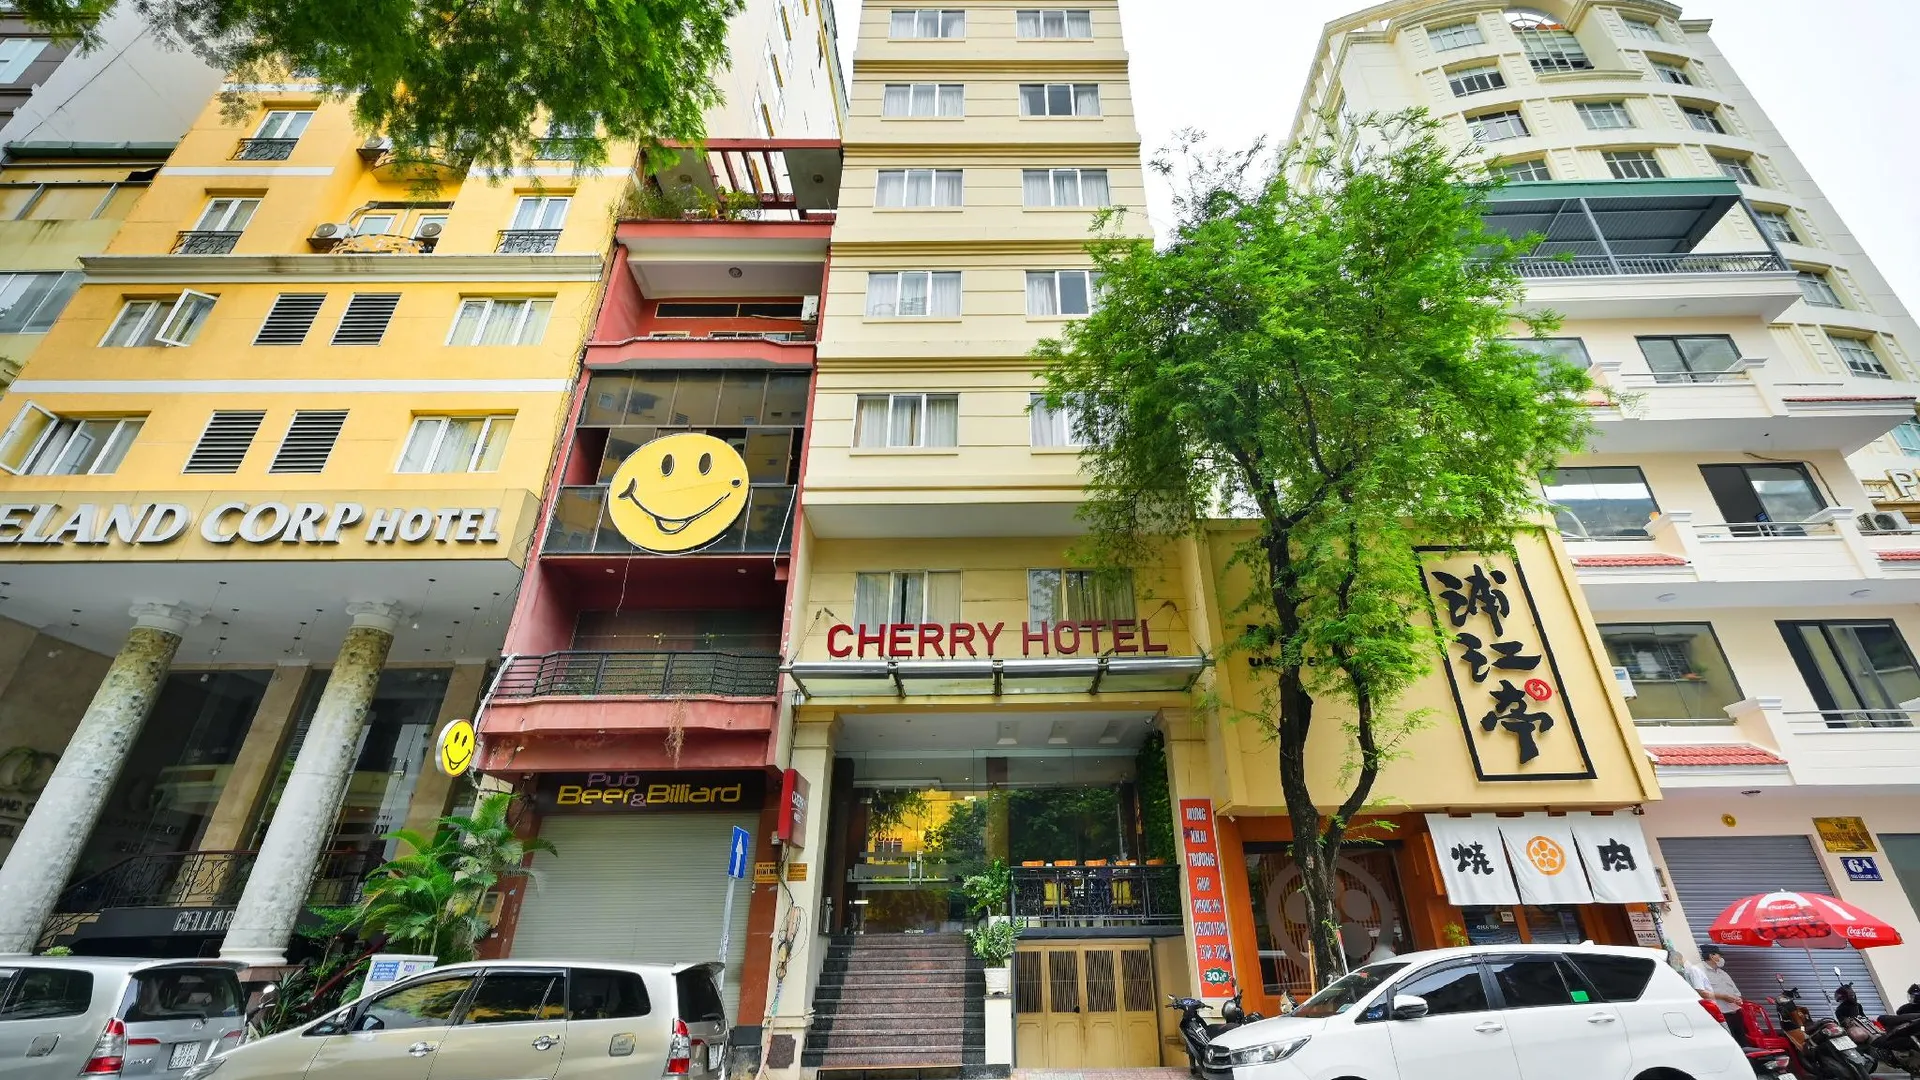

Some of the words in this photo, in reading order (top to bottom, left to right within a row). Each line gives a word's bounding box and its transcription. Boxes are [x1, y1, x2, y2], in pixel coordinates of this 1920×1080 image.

[200, 501, 365, 544] CORP
[364, 507, 500, 543] HOTEL
[827, 622, 1005, 658] CHERRY
[1022, 618, 1168, 655] HOTEL
[588, 772, 641, 788] Pub
[1597, 838, 1637, 872] 肉
[1847, 859, 1873, 874] 6A
[173, 909, 235, 932] CELLAR
[1846, 925, 1878, 939] Coca-Cola
